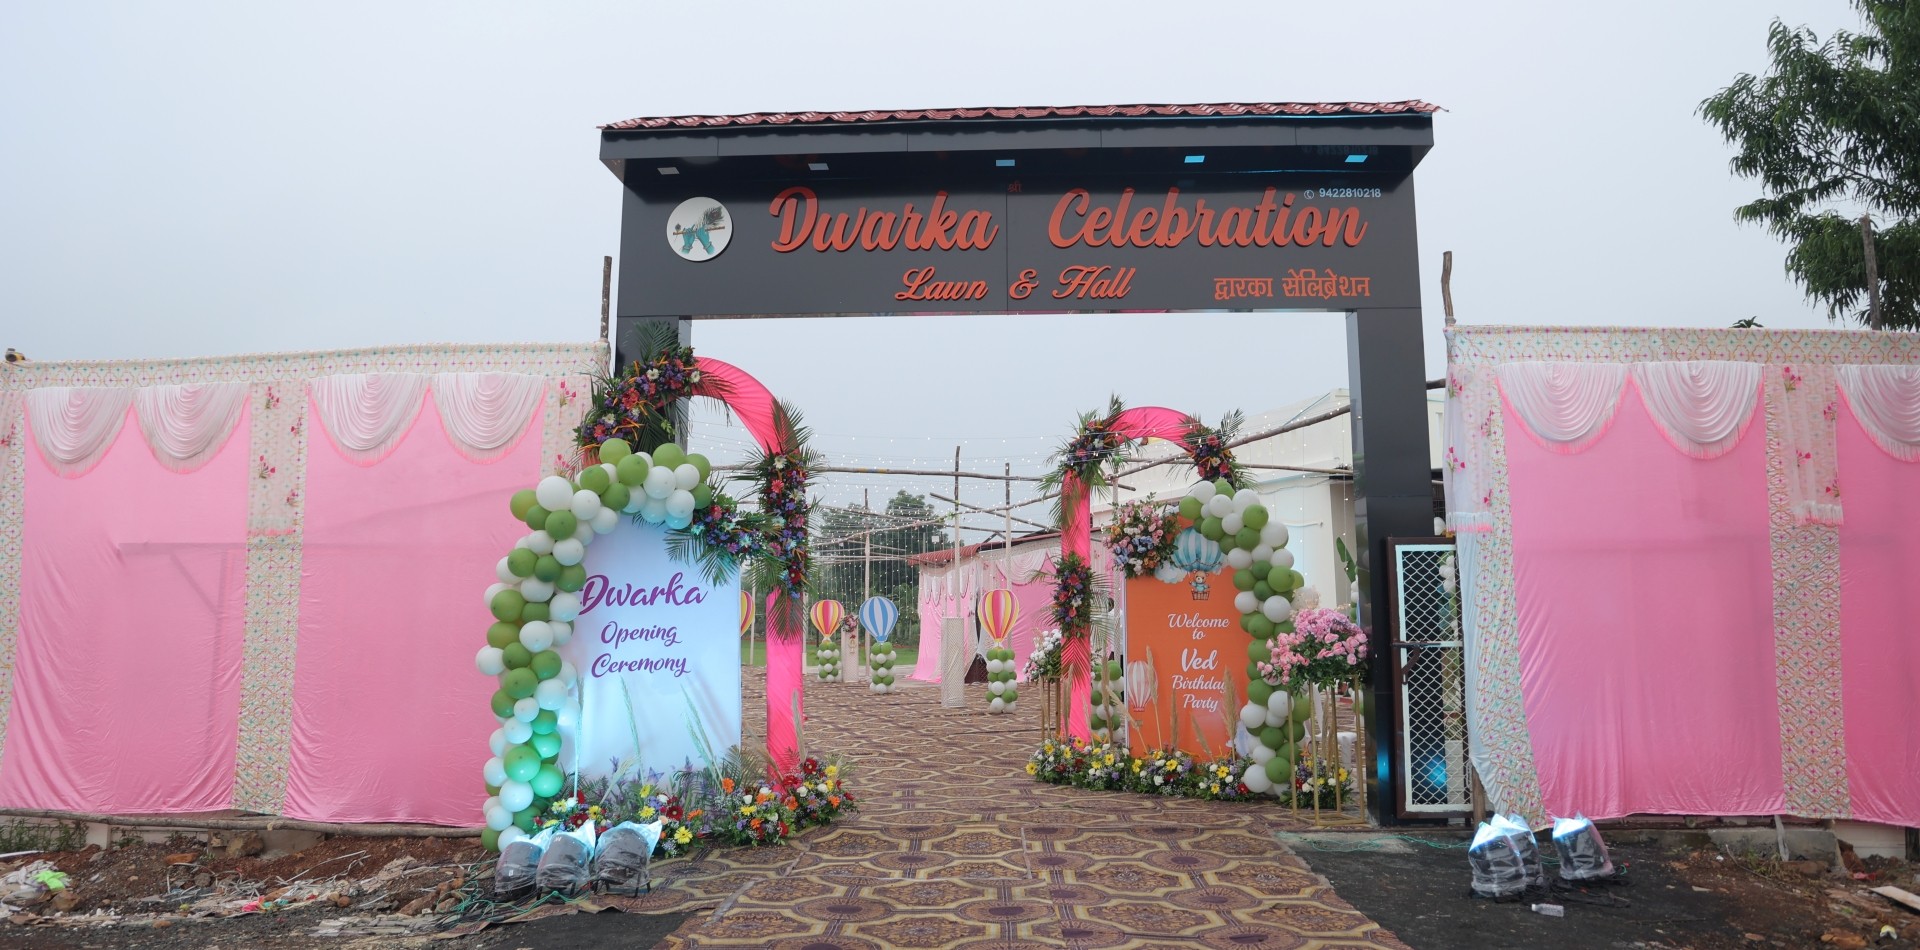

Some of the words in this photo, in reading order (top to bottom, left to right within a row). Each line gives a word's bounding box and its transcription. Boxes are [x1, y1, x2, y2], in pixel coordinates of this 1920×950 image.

[1008, 180, 1022, 193] श्री
[1319, 188, 1381, 198] 9422810218
[768, 186, 998, 252] Dwarka
[1048, 186, 1368, 248] Celebration
[895, 266, 988, 300] Lawn
[1009, 269, 1039, 299] &
[1052, 265, 1136, 299] Hall
[1214, 277, 1273, 300] द्वारका
[1282, 268, 1370, 300] सेलिब्रेशन
[578, 572, 708, 615] Dwarka
[1167, 613, 1229, 628] Welcome
[601, 621, 682, 649] Opening
[1192, 628, 1205, 640] to
[591, 653, 691, 677] Ceremony
[1181, 648, 1218, 672] Ved
[1171, 674, 1226, 693] Birthday
[1183, 693, 1218, 712] Party
